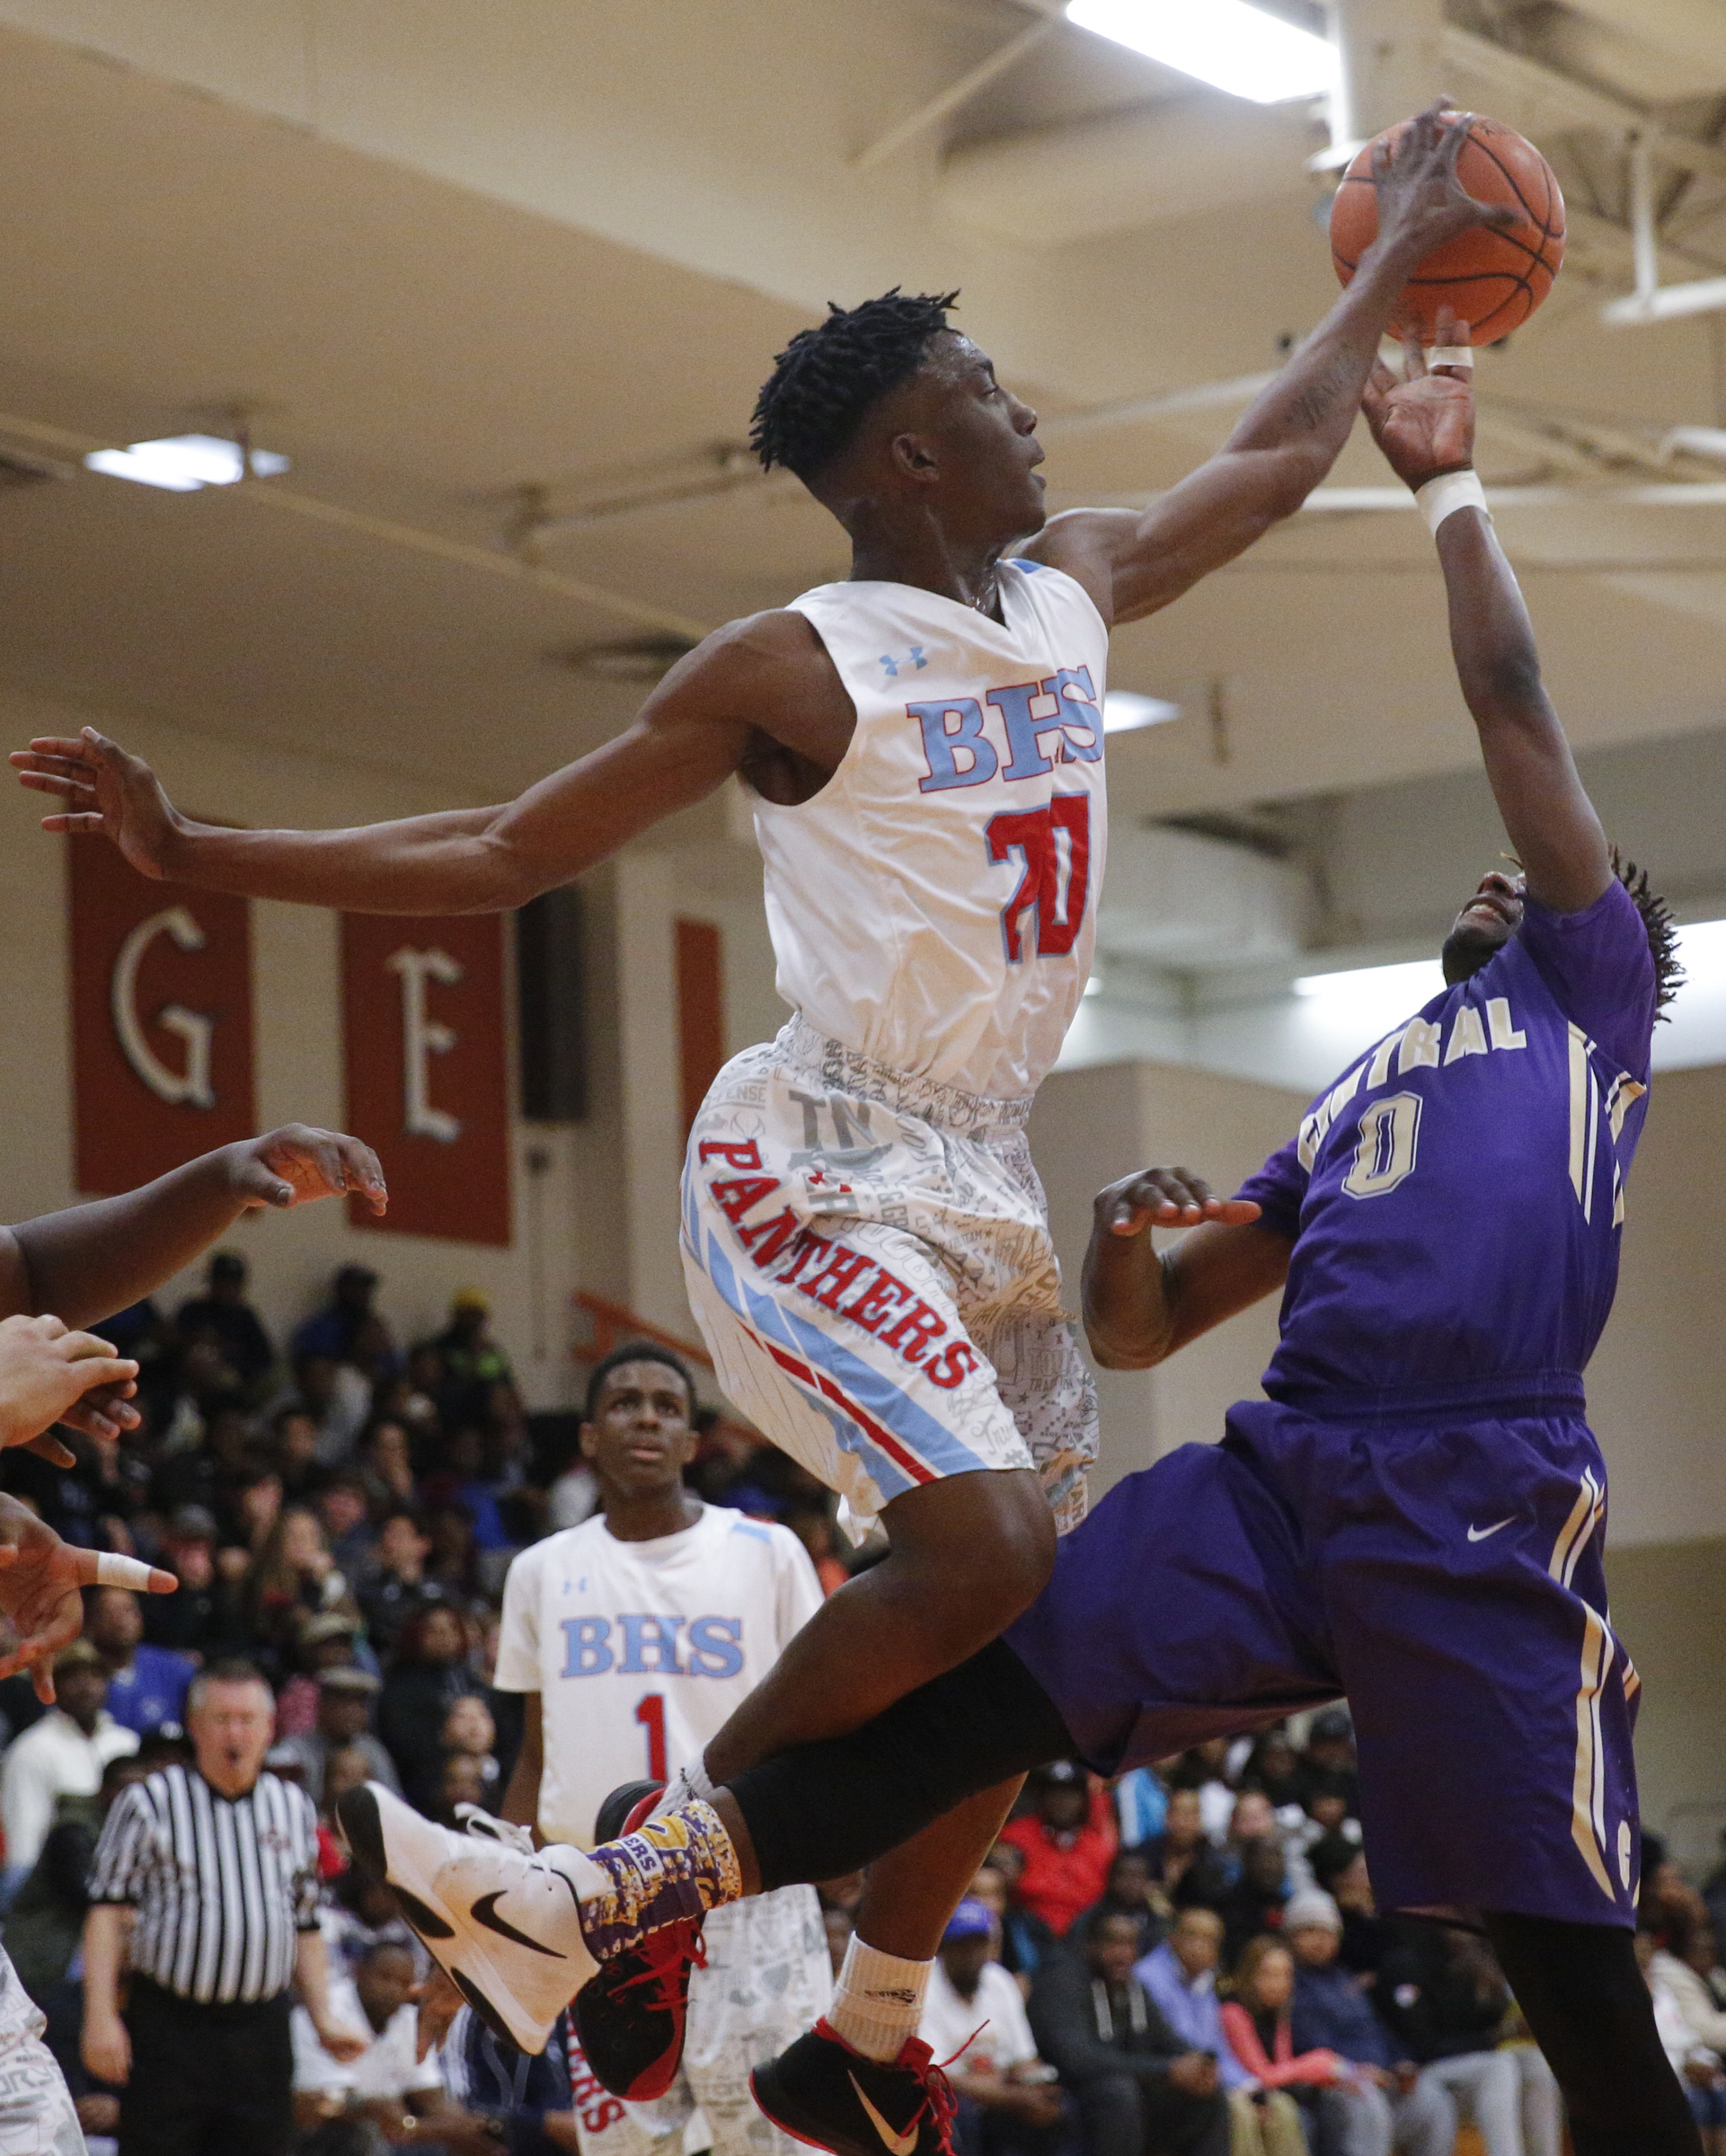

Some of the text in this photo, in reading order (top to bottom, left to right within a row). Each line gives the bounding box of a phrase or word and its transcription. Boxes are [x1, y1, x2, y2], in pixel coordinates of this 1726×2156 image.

[906, 664, 1104, 793] BHS
[983, 790, 1091, 965] 20
[111, 906, 216, 1109] G
[385, 945, 463, 1144] E
[1341, 1090, 1423, 1200] 0
[697, 1136, 980, 1391] PANTHERS
[560, 1613, 745, 1679] BHS
[635, 1692, 668, 1784] 1
[624, 1834, 657, 1872] ERS
